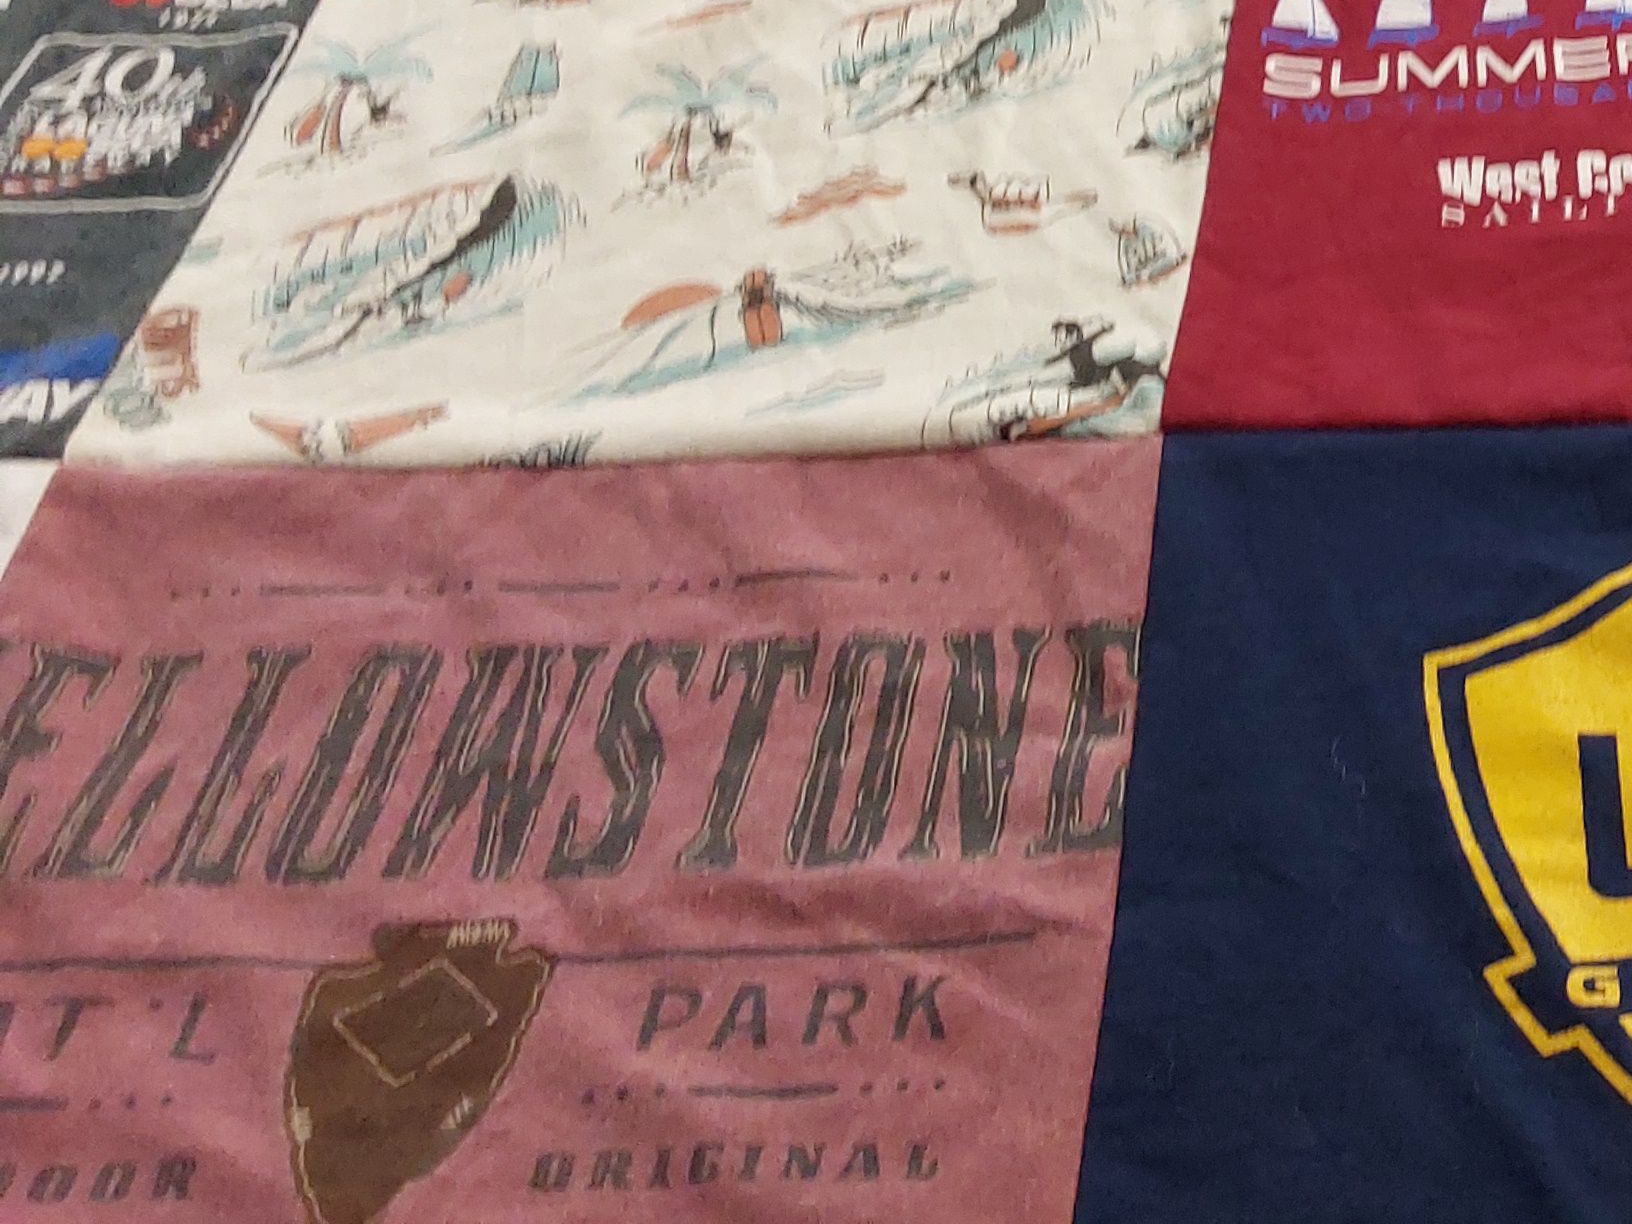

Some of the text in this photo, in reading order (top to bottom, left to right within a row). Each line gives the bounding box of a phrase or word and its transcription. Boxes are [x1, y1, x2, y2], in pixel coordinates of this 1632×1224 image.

[1263, 95, 1372, 124] TWO
[1437, 149, 1562, 207] West
[636, 975, 950, 1053] PARK
[527, 1141, 943, 1193] ORIGINAL
